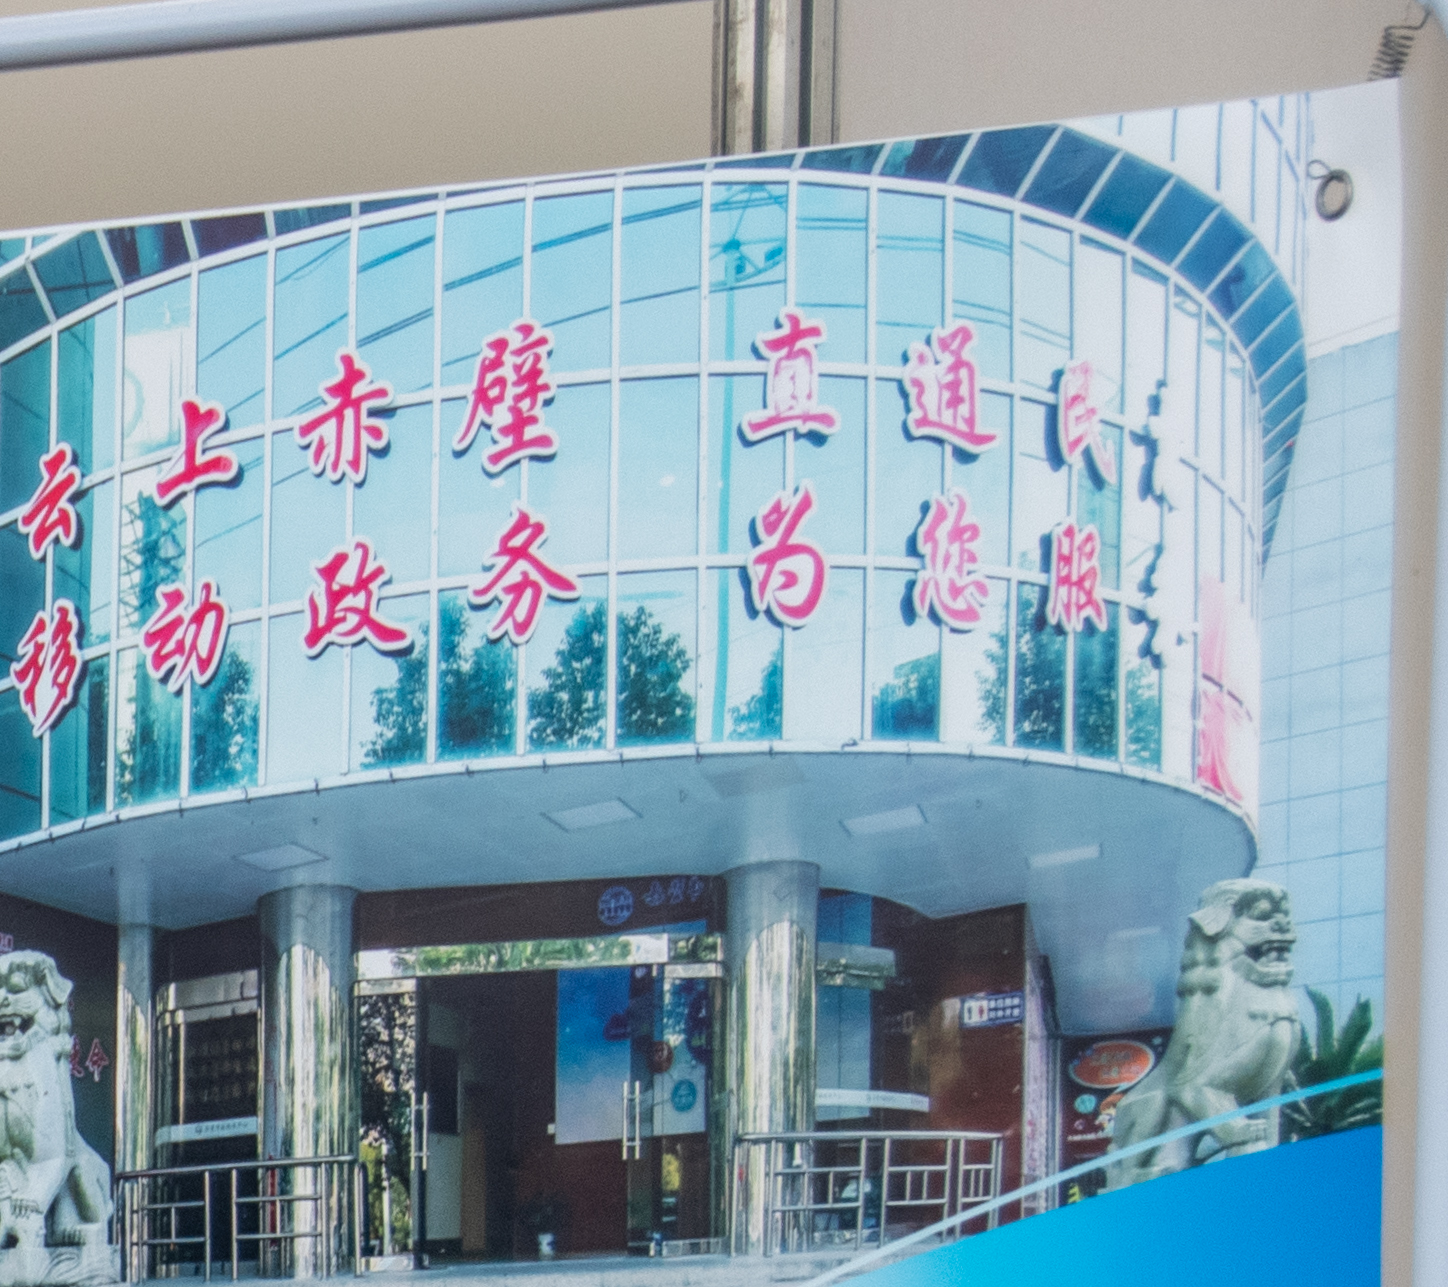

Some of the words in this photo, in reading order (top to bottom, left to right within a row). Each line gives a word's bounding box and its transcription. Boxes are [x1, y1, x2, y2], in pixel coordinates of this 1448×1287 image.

[18, 318, 558, 560] 云上赤壁
[741, 312, 1178, 512] 直通民
[10, 502, 582, 738] 移动政务
[742, 486, 1186, 668] 为您服
